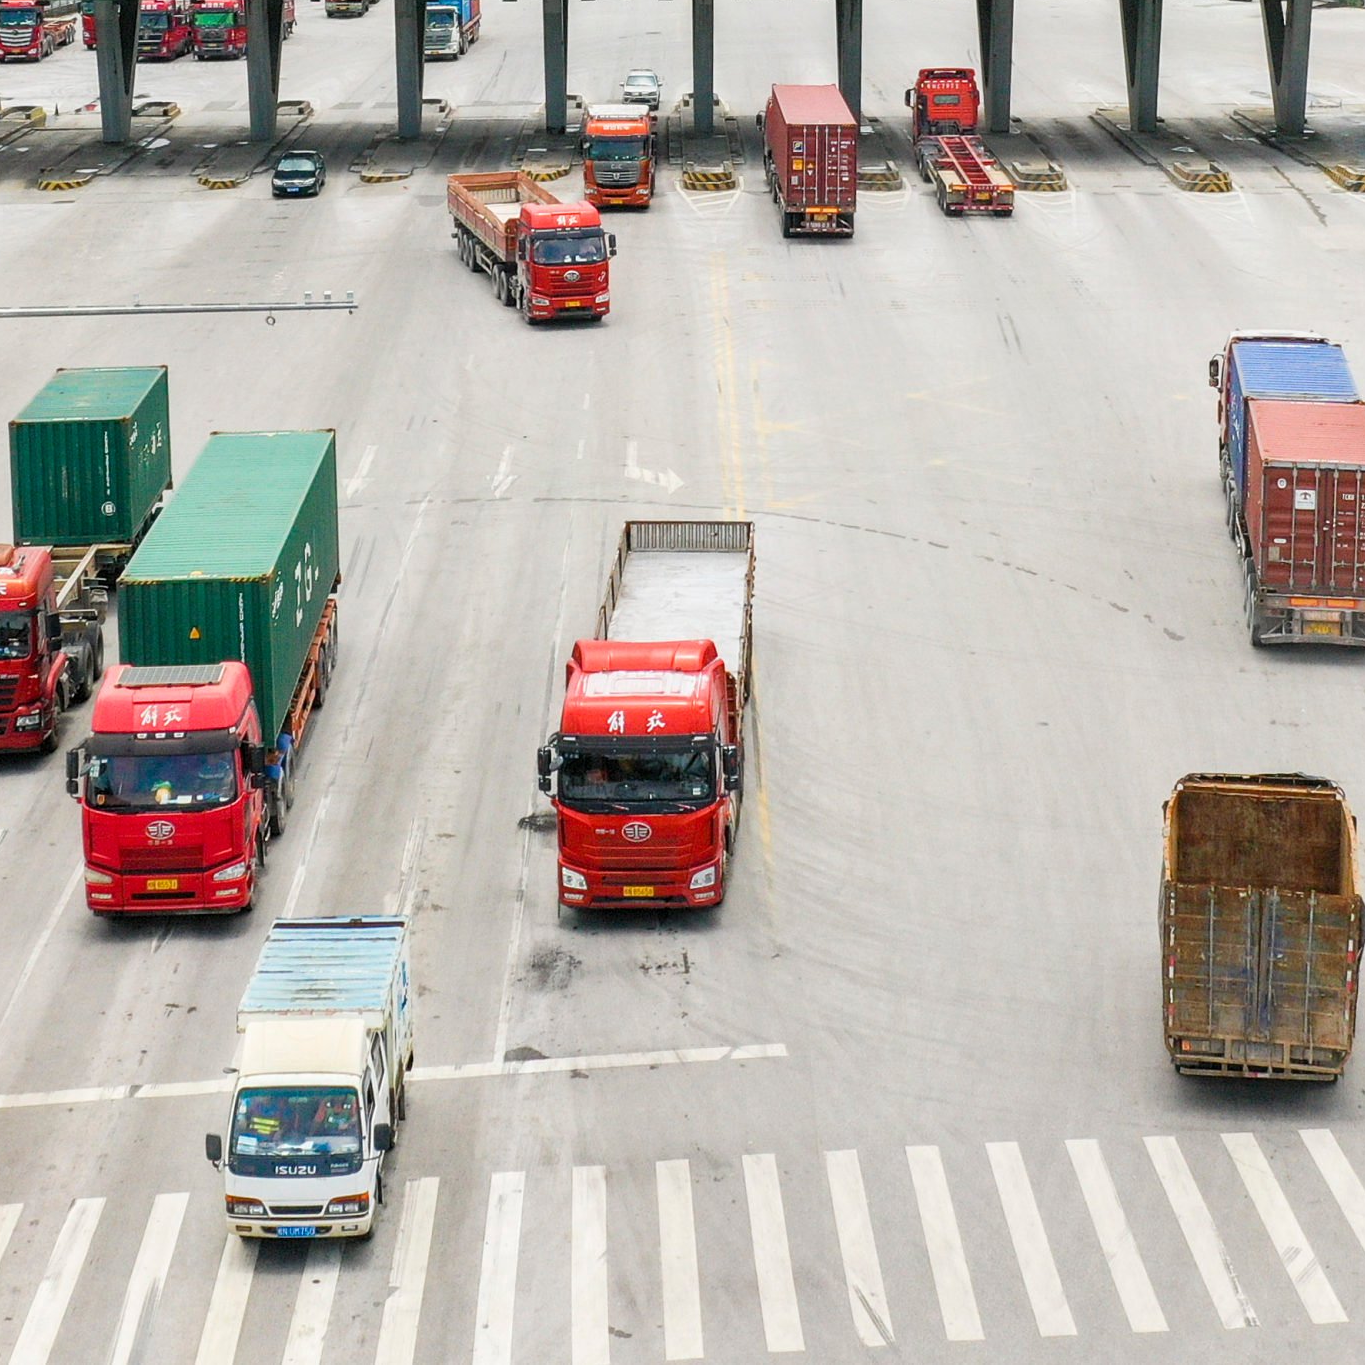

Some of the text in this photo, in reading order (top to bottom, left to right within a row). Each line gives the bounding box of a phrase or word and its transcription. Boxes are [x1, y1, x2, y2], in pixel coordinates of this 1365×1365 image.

[140, 703, 183, 728] 解放
[607, 709, 666, 734] 解放
[275, 1165, 317, 1175] ISUZU
